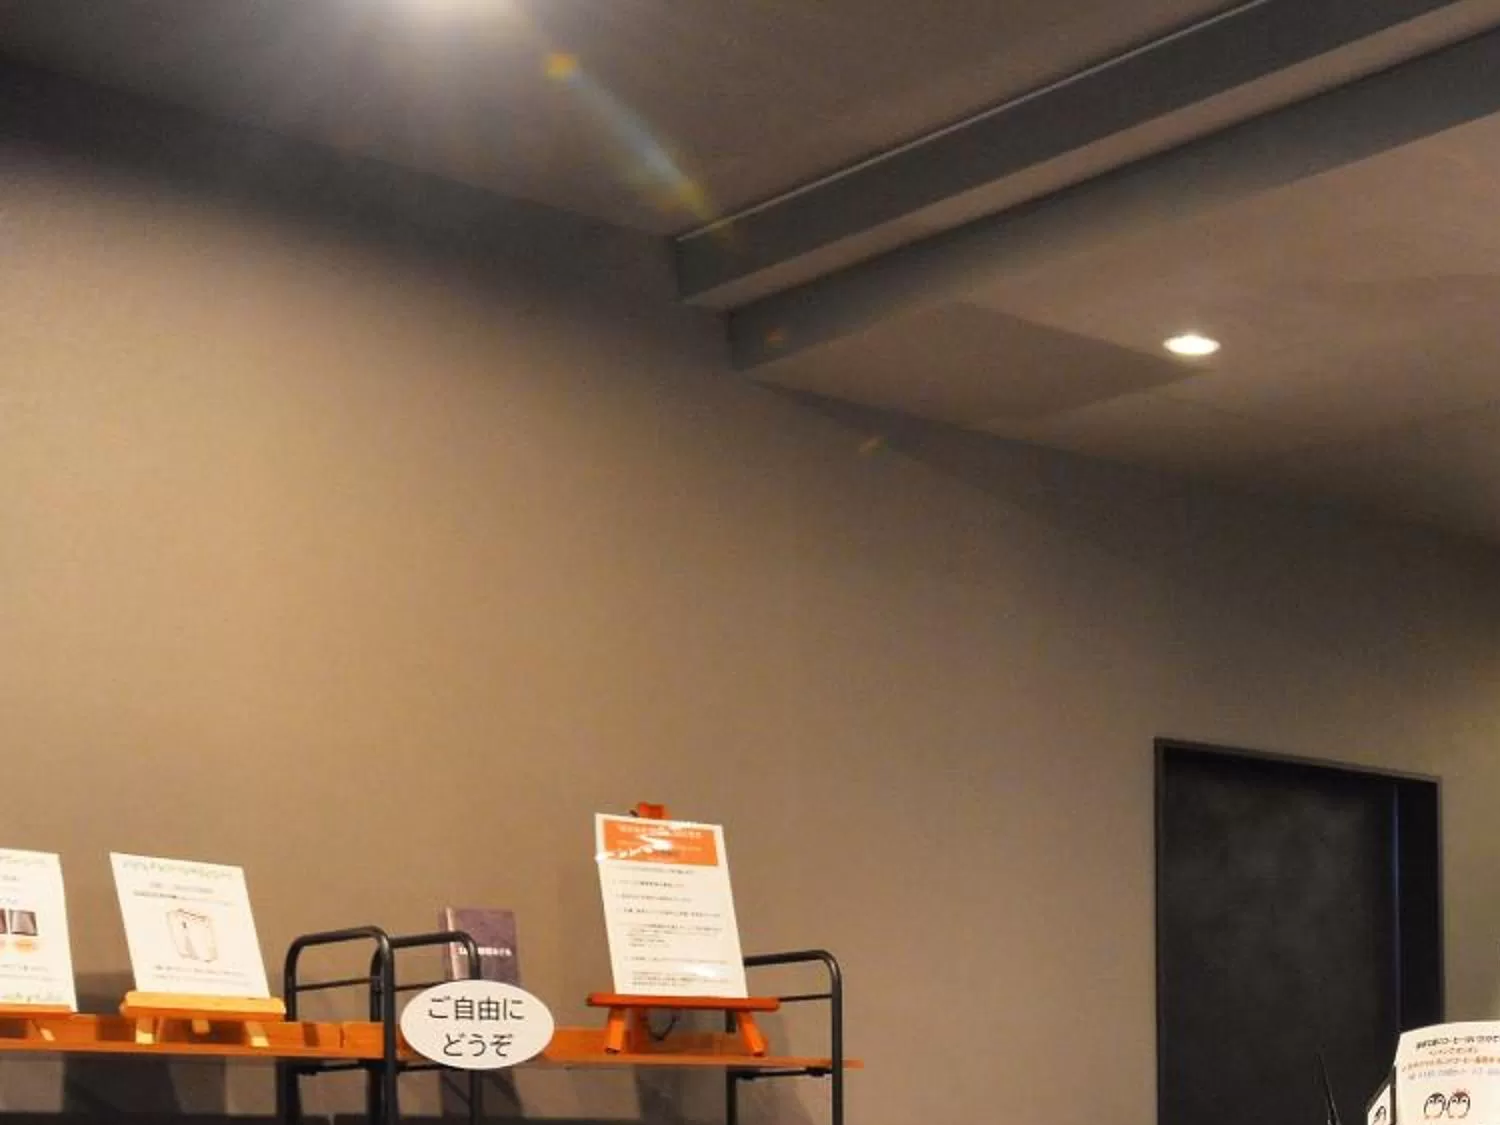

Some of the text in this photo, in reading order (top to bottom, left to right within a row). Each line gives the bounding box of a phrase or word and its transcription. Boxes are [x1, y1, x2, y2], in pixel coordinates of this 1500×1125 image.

[428, 995, 525, 1022] ご自由に
[443, 1031, 514, 1058] どうぞ
